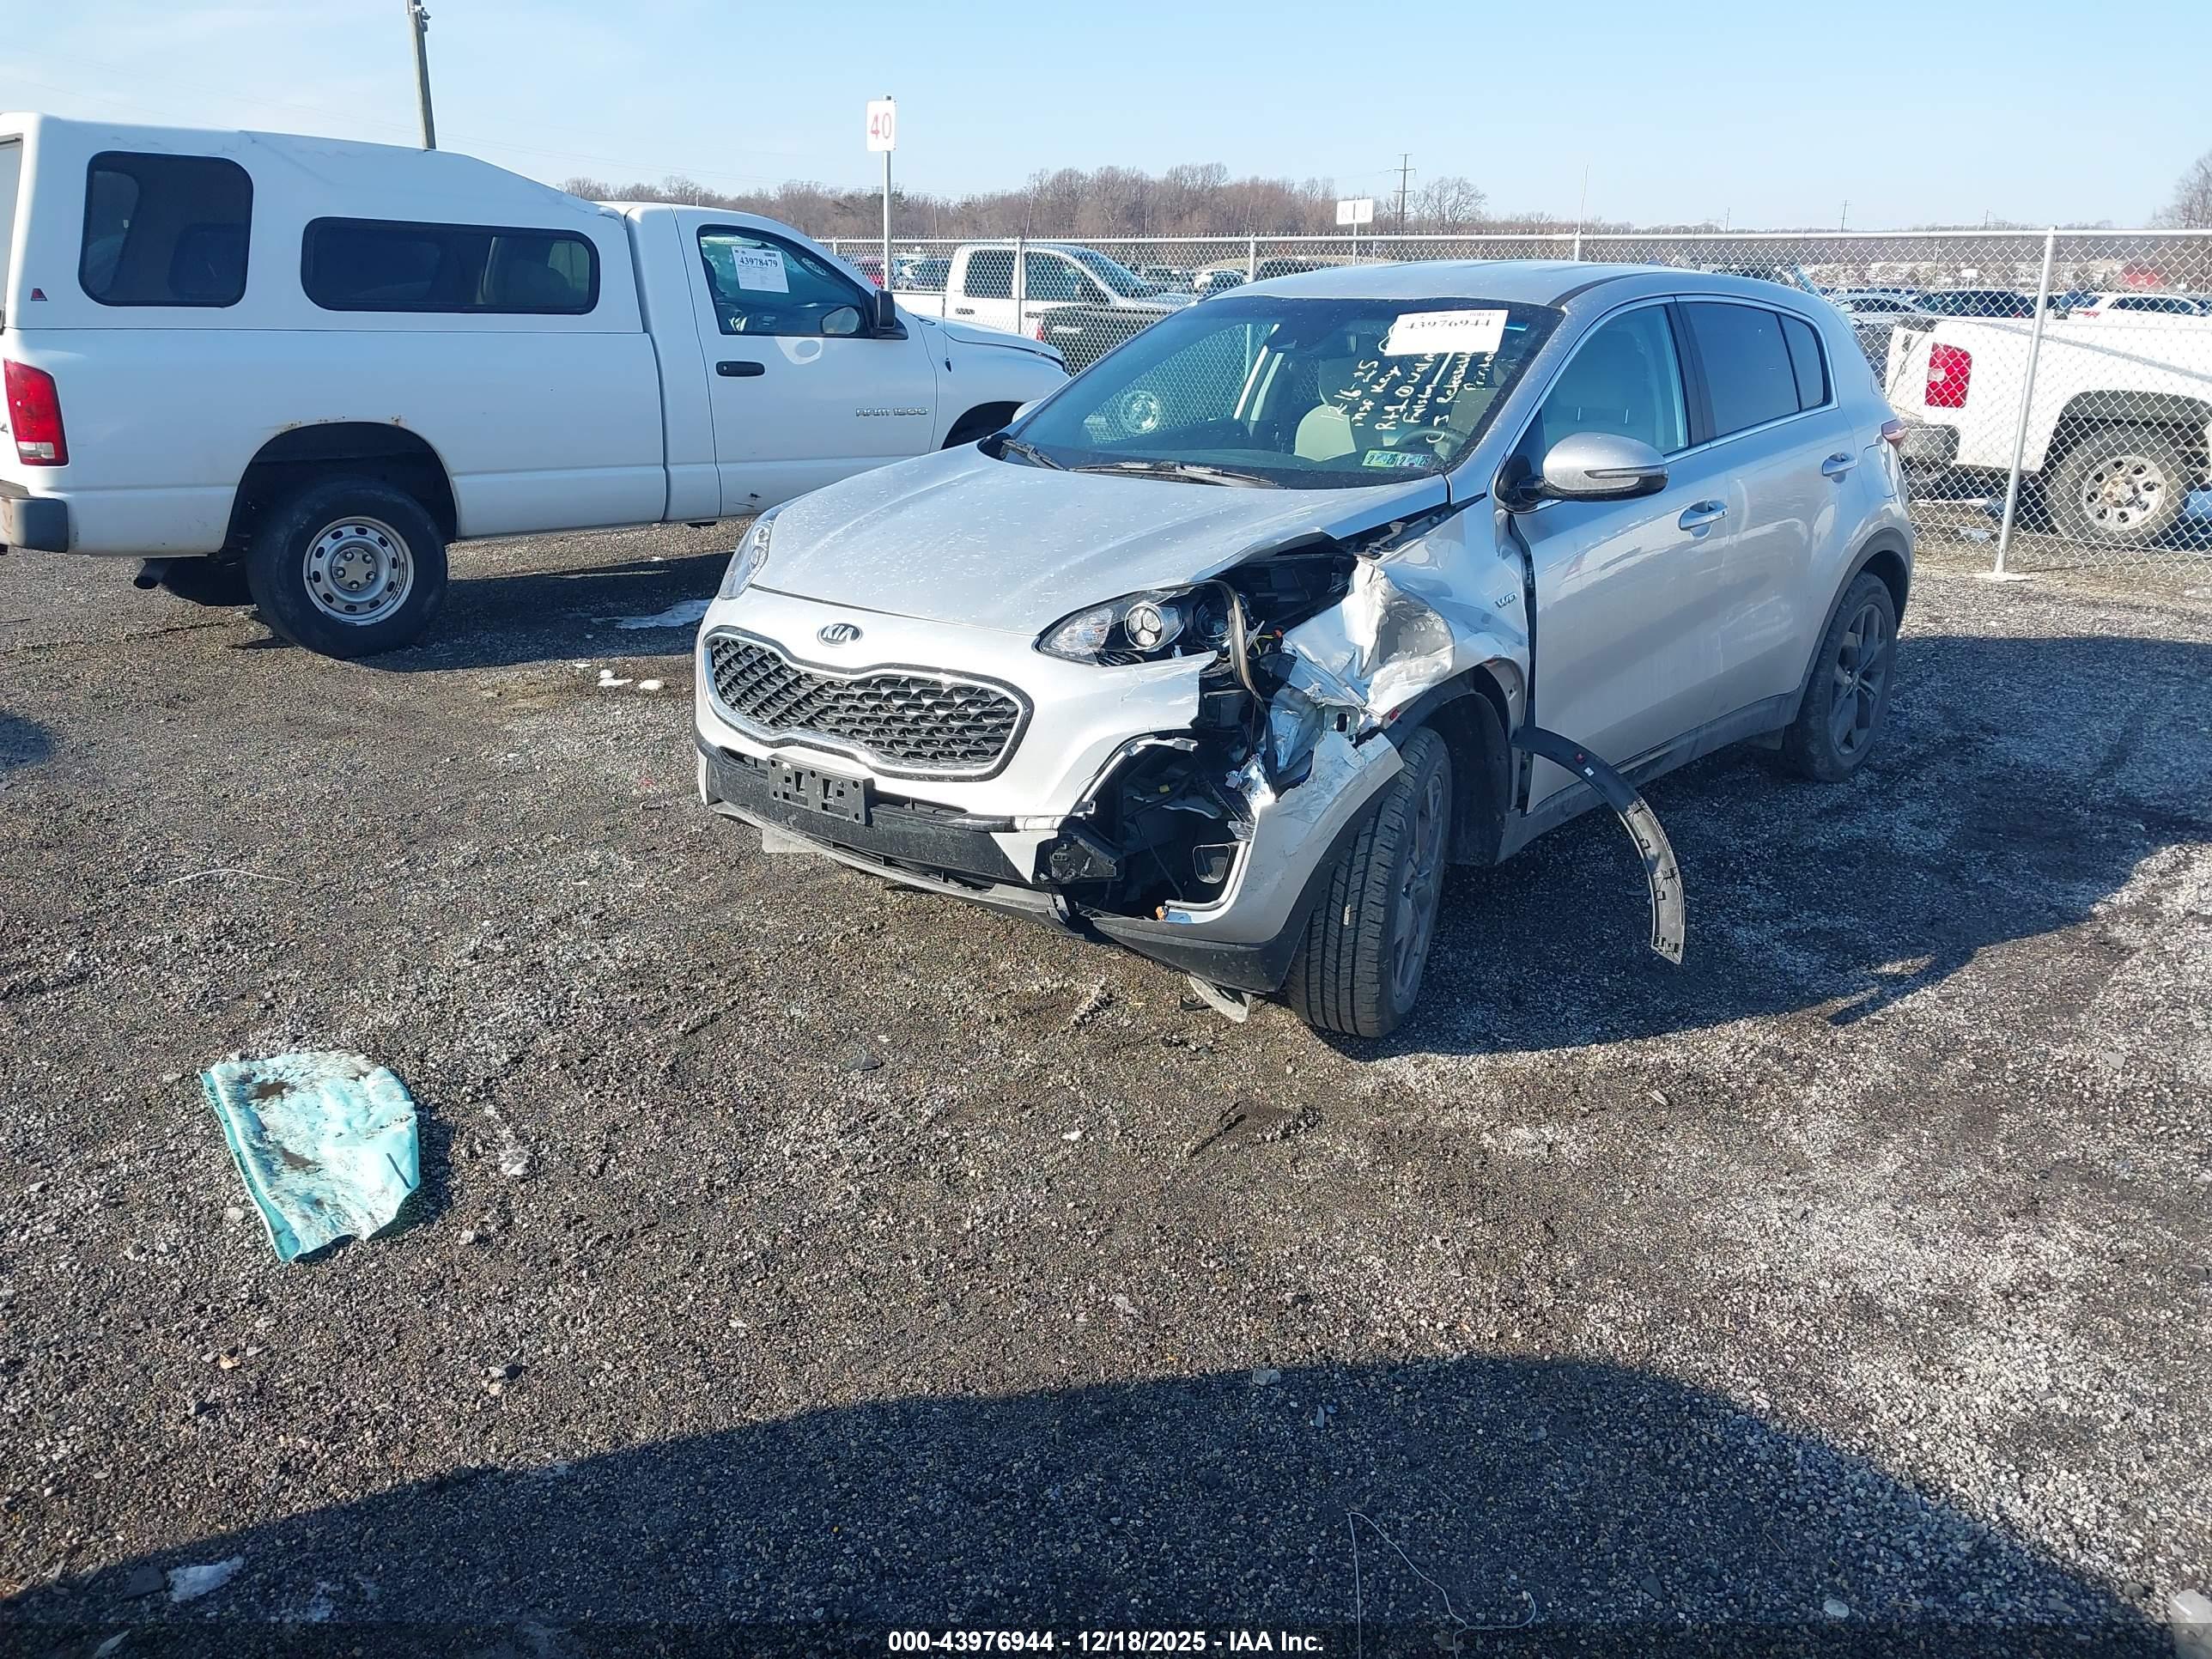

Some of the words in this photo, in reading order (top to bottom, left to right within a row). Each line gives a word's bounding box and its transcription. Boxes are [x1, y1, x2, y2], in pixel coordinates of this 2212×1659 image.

[871, 112, 892, 139] 40
[739, 256, 778, 267] 43978479
[892, 407, 928, 416] 1500
[822, 624, 854, 643] KIA
